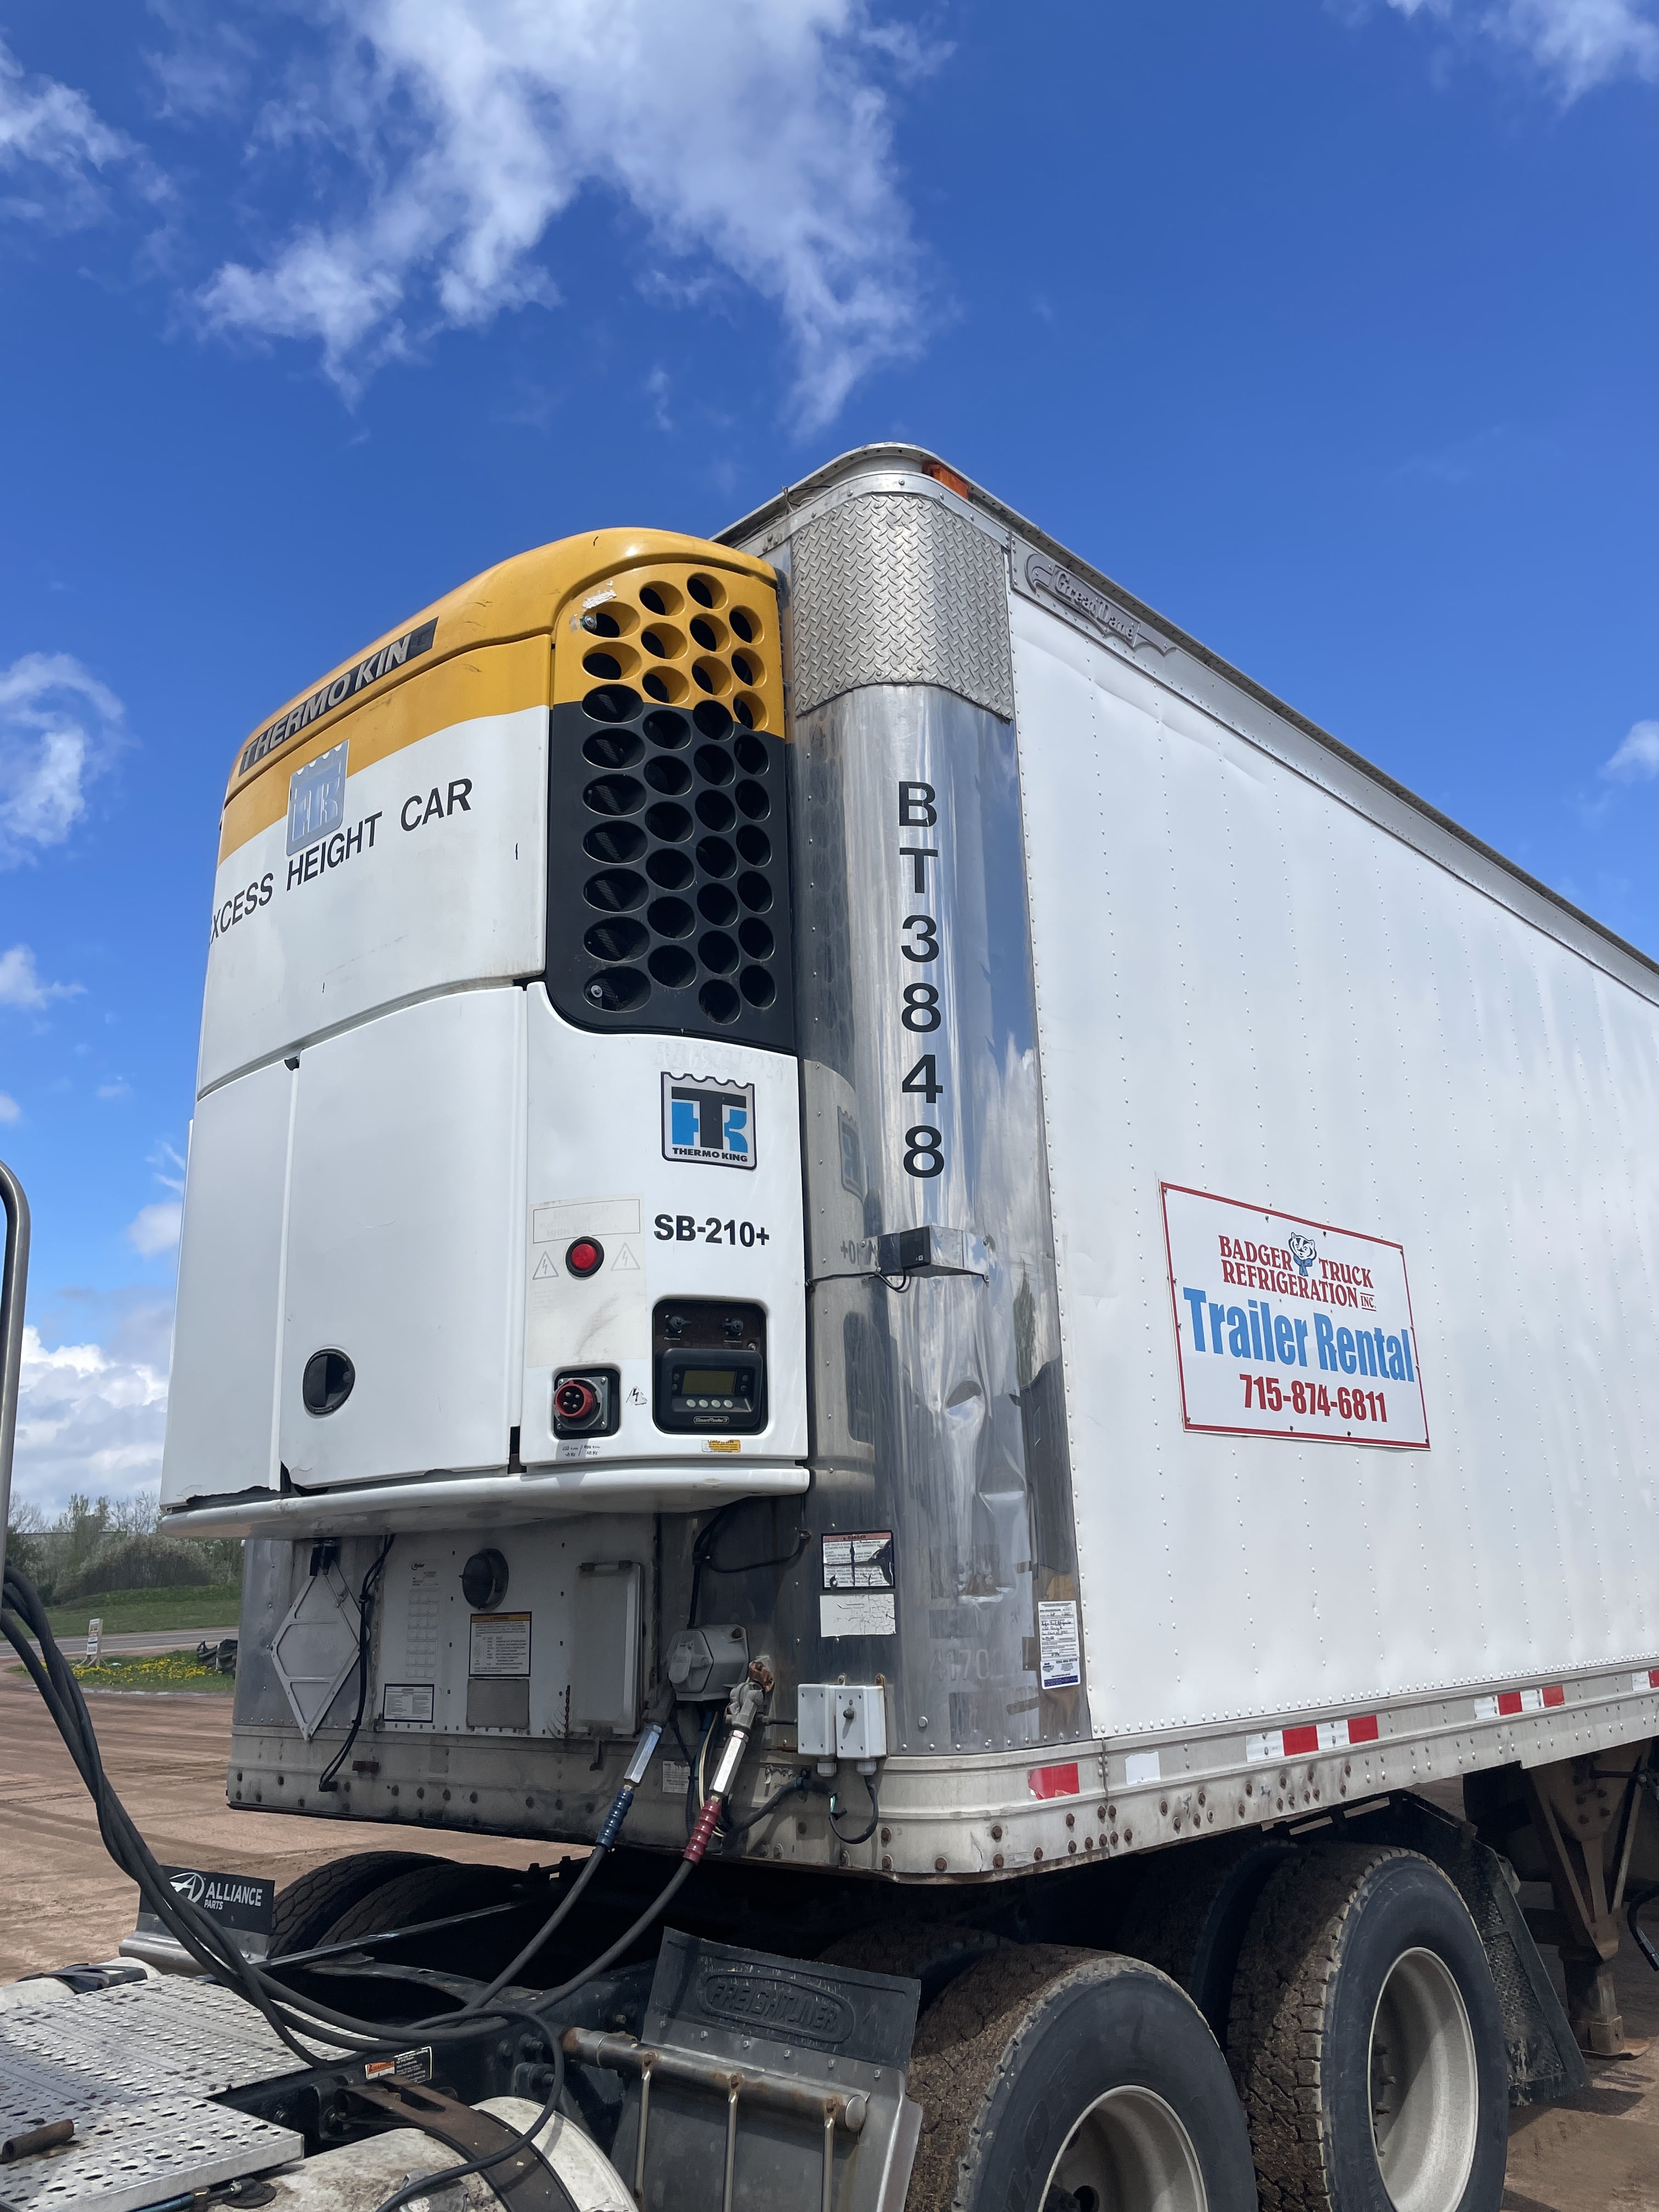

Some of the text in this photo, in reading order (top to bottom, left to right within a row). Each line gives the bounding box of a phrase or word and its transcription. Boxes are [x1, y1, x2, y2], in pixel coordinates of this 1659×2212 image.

[244, 634, 413, 770] THERMO KIN
[286, 811, 382, 891] HEIGHT
[401, 778, 472, 831] CAR
[672, 1147, 748, 1162] THERMO KING
[654, 1214, 770, 1247] SB-210+
[1218, 1235, 1374, 1289] BADGER TRUCK
[1221, 1259, 1359, 1308] REFRIGERATION
[1183, 1287, 1415, 1383] Trailer Rental
[1239, 1374, 1387, 1423] 715-874-6811
[204, 1899, 224, 1910] PARTS
[205, 1882, 263, 1906] ALLIANCE
[710, 1983, 839, 2029] FREIGHTLINER
